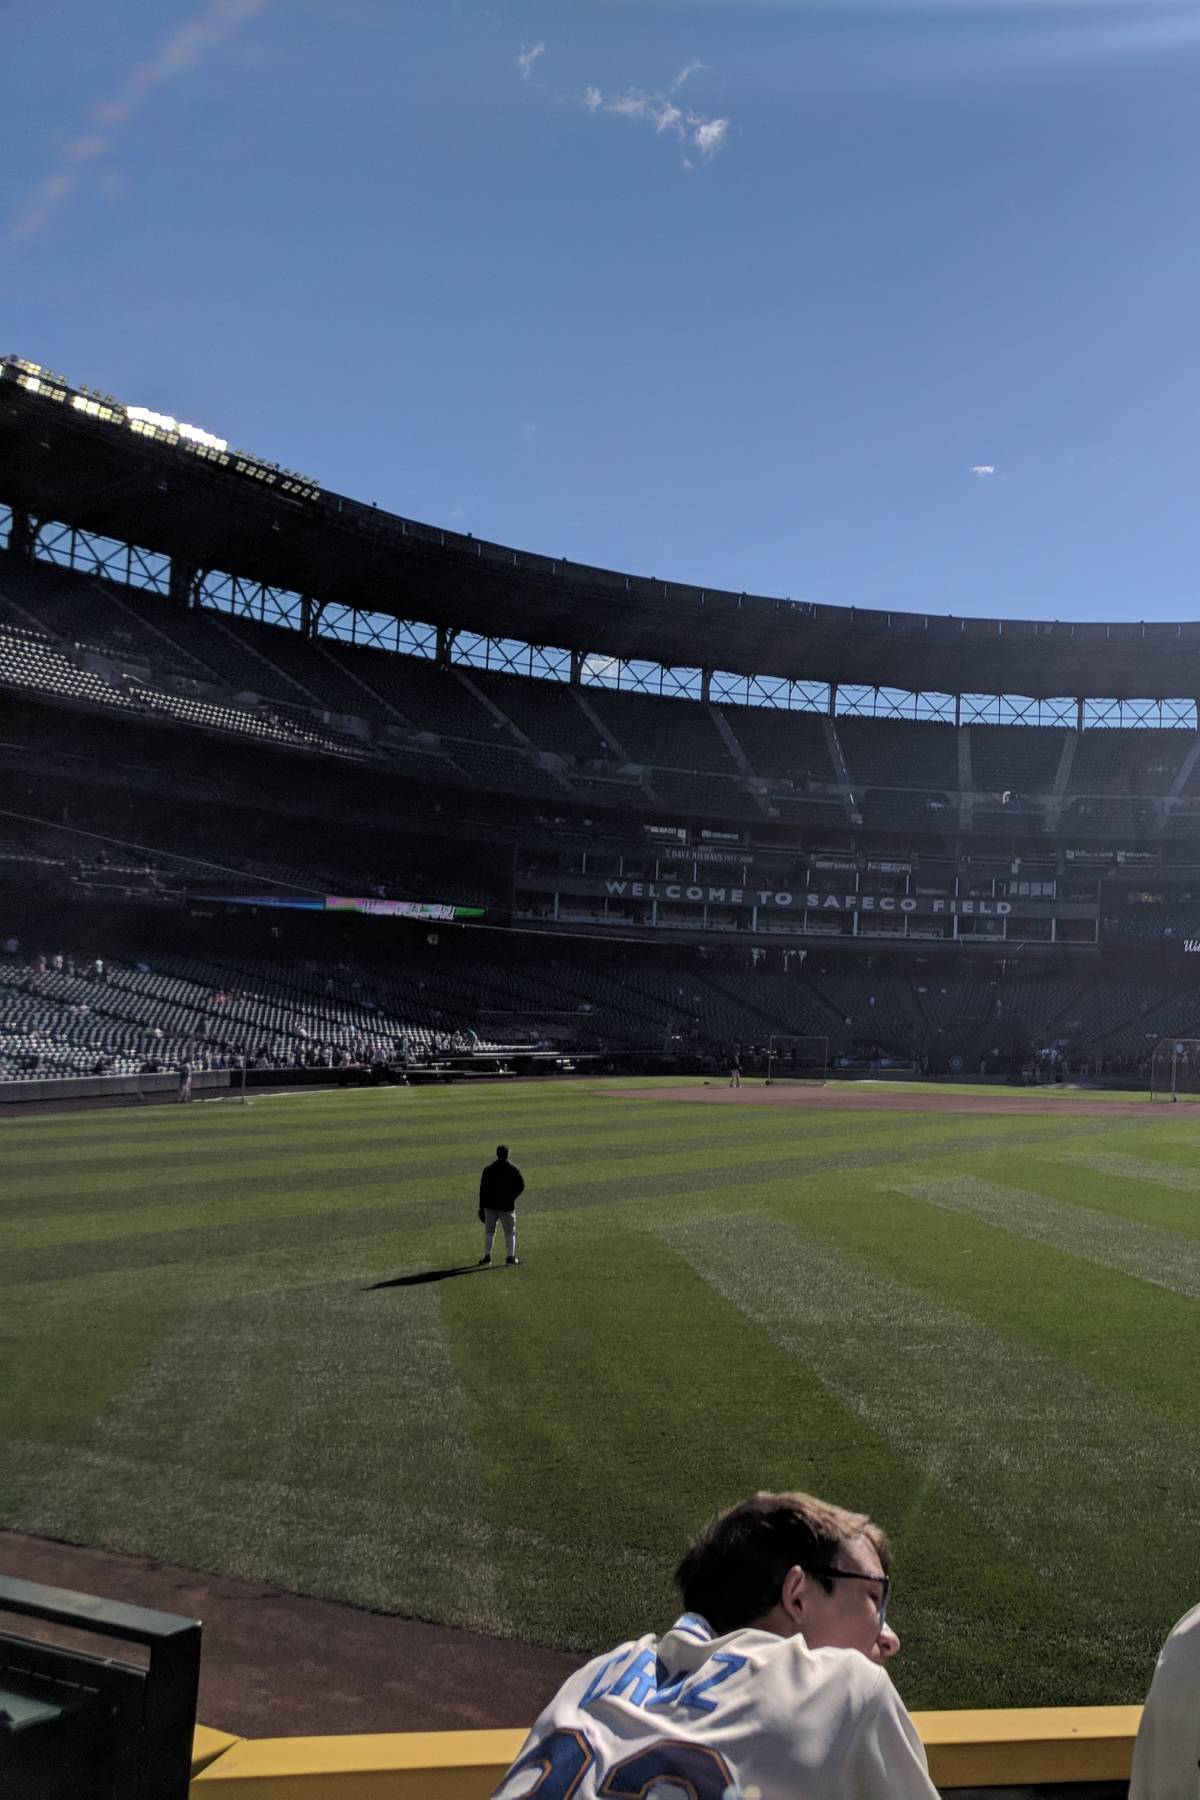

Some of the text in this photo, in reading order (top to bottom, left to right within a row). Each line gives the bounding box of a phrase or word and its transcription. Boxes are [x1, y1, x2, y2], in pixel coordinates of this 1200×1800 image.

[606, 880, 1012, 915] WELCOME TO SAFECO FIELD
